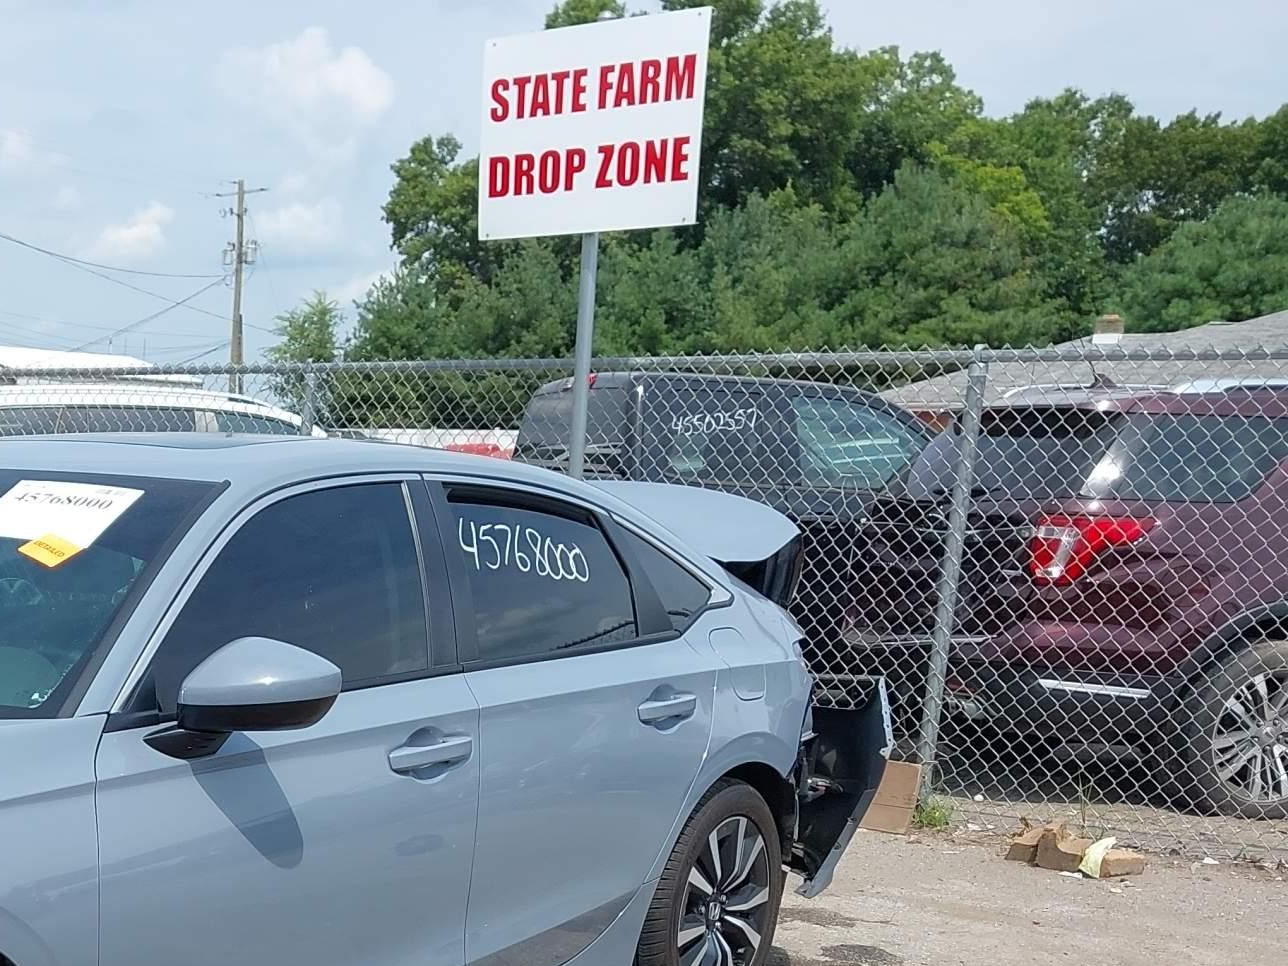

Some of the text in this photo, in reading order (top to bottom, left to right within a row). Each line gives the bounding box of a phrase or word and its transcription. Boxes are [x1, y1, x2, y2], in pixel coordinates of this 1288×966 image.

[490, 54, 697, 122] STATE FARM
[488, 136, 690, 198] DROP ZONE
[672, 408, 757, 435] 45502557
[15, 491, 113, 510] 45768000
[458, 517, 589, 582] 45768000
